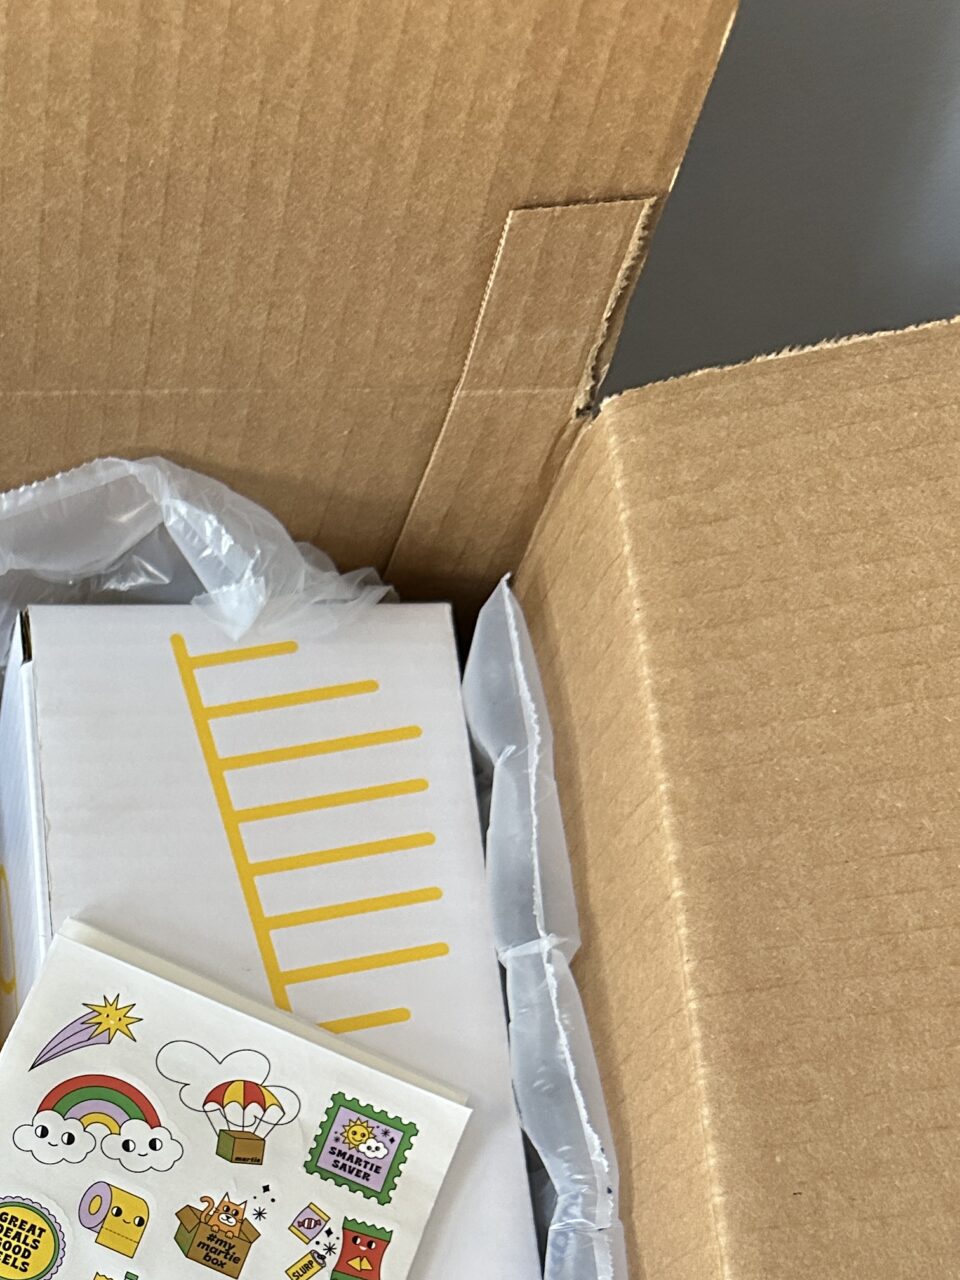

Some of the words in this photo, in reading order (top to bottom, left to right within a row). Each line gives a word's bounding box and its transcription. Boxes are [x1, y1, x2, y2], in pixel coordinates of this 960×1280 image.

[329, 1146, 383, 1175] SMARTIE
[331, 1159, 371, 1182] SAVER
[0, 1211, 46, 1239] GREAT
[197, 1240, 241, 1265] martie
[206, 1233, 236, 1253] #my
[202, 1251, 227, 1269] box
[292, 1259, 315, 1280] SLURP
